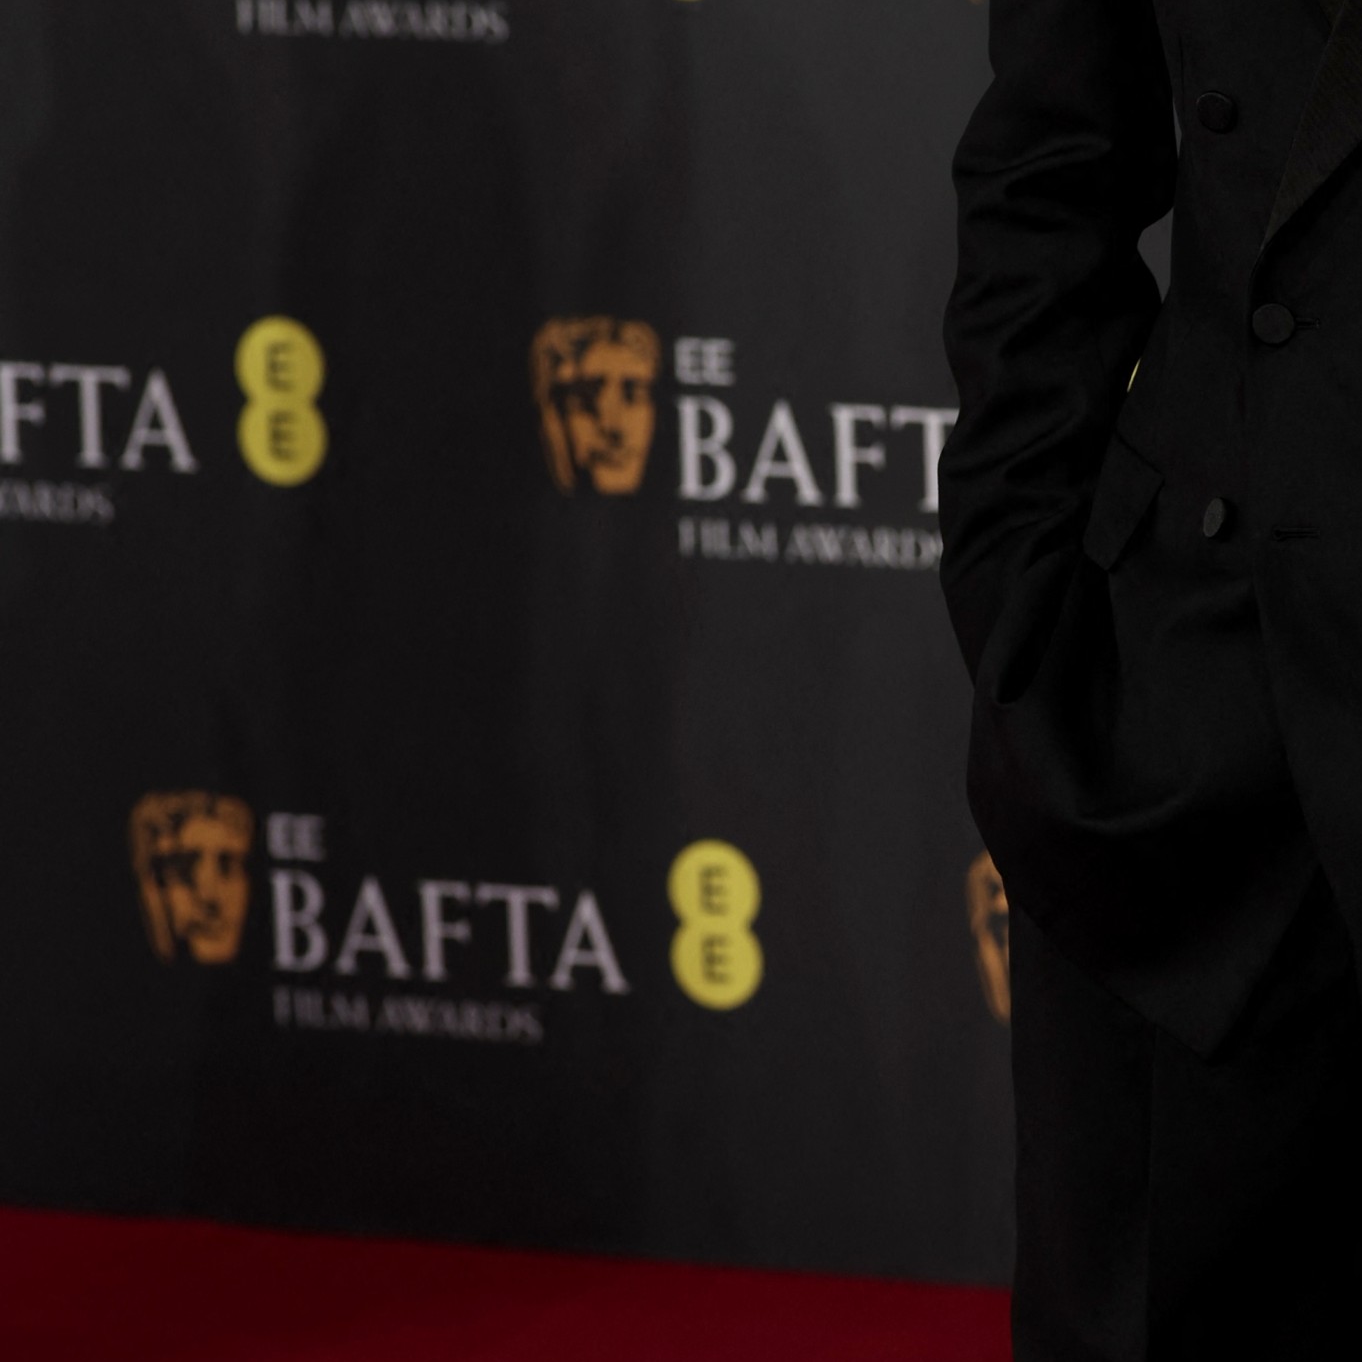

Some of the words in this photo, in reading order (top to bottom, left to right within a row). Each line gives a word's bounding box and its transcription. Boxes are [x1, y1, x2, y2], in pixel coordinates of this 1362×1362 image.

[673, 337, 734, 386] EE
[677, 518, 780, 561] FILM
[786, 525, 945, 569] AWARD
[265, 812, 323, 861] EE
[271, 870, 629, 993] BAFTA
